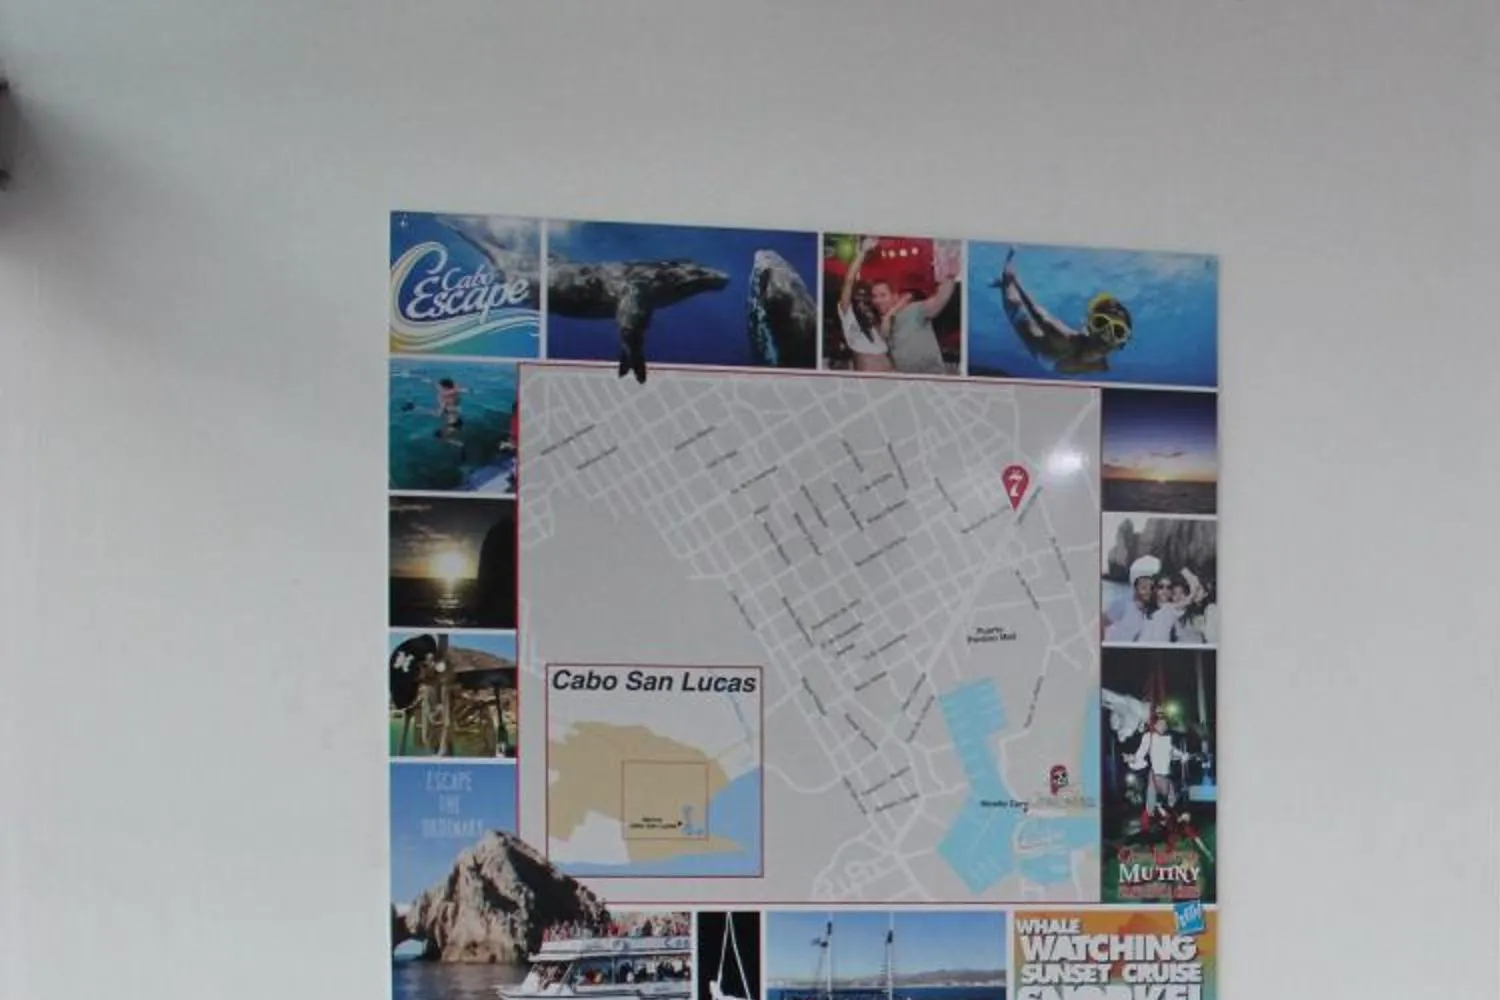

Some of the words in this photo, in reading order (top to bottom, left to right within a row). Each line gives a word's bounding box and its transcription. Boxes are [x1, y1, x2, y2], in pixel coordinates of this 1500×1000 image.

[440, 264, 494, 290] Cabo
[406, 272, 529, 324] Escape
[552, 669, 617, 692] Cabo
[625, 670, 673, 692] San
[682, 671, 757, 693] Lucas
[1119, 863, 1200, 884] MUTINY
[1016, 918, 1082, 935] WHALE
[1021, 934, 1198, 962] WATCHING
[1020, 963, 1111, 985] SUNSET
[1121, 963, 1204, 984] CRUISE
